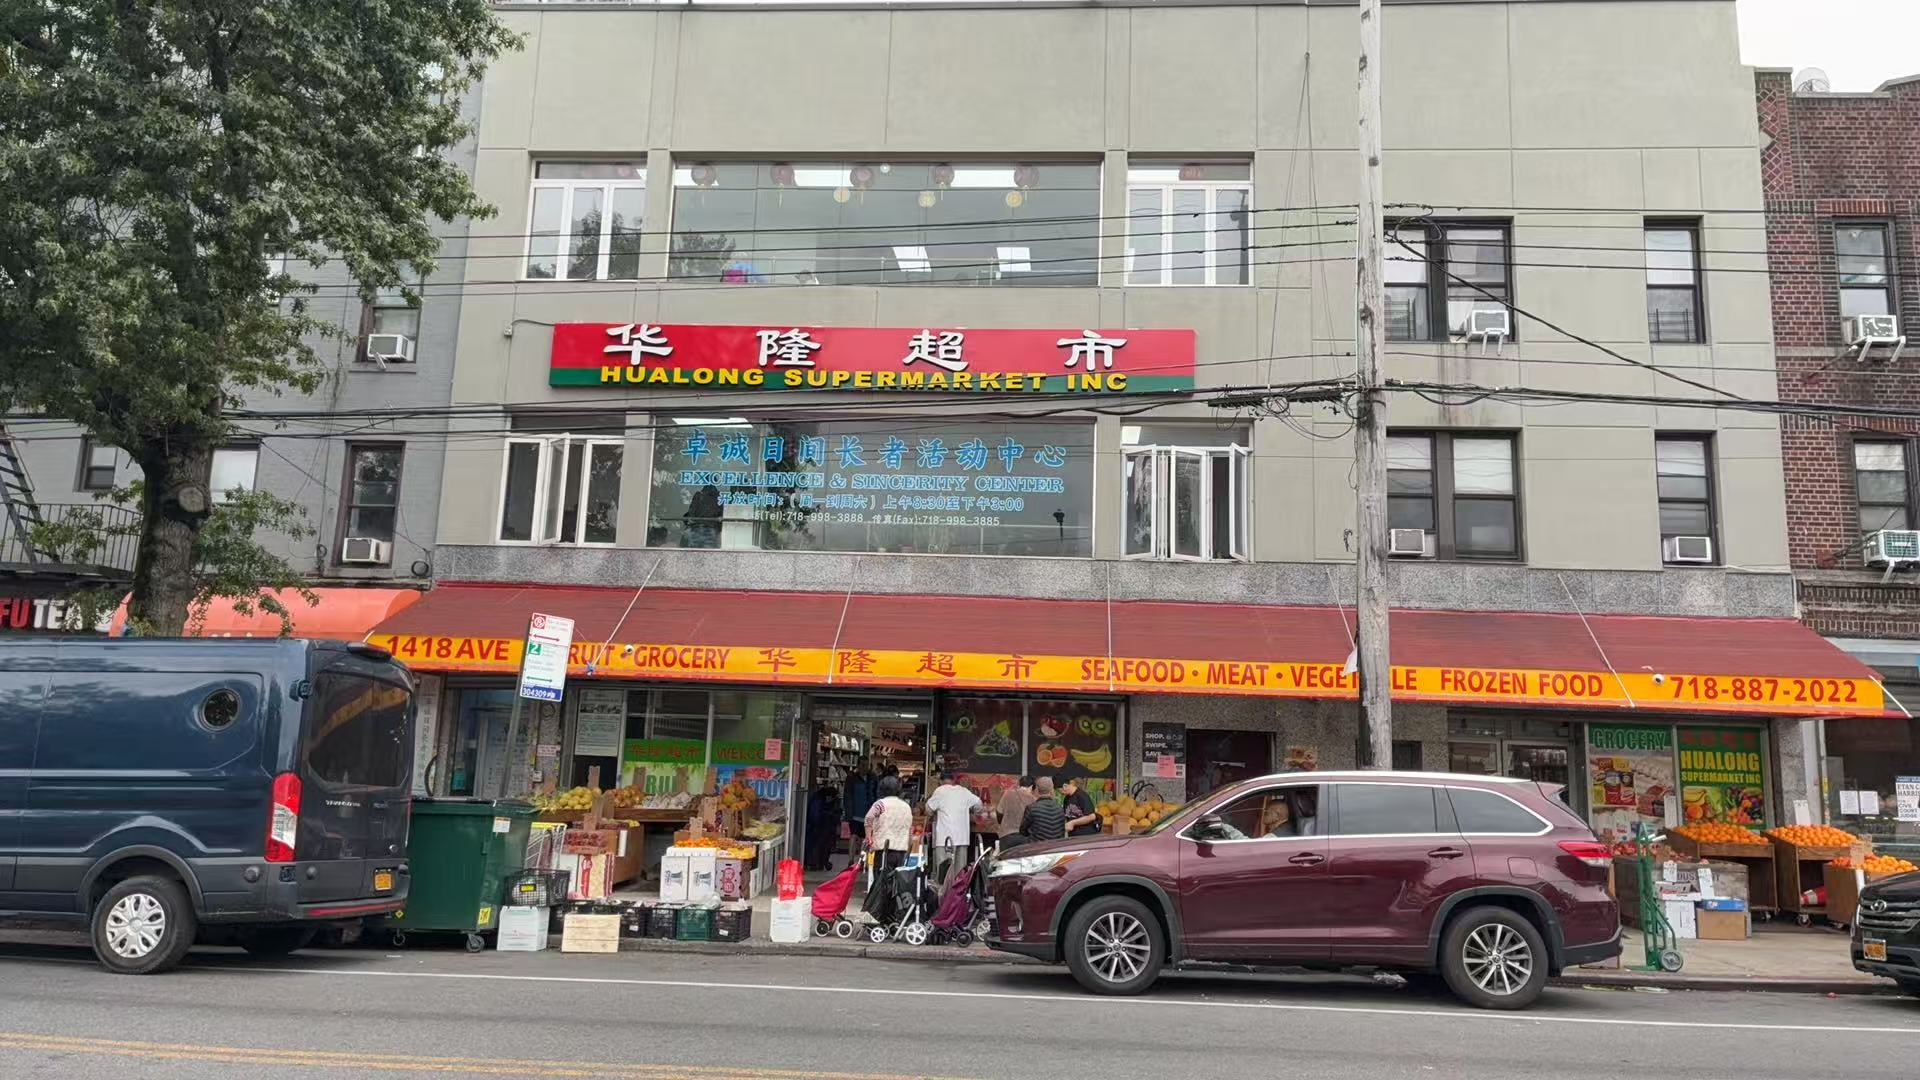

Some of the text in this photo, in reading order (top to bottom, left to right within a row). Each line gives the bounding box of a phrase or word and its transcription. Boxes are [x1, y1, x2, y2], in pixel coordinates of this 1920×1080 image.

[603, 324, 1127, 371] 华隆超市
[601, 366, 1127, 391] HUALONG SUPERMARKET INC
[680, 429, 1066, 473] 卓诚日间长者活动中心
[679, 471, 1064, 493] EXCELLENCE & SINCERITY CENTER
[386, 636, 511, 661] 1418 AVE
[568, 644, 616, 669] RUIT
[633, 646, 731, 669] GROCERY
[757, 648, 1038, 679] 华隆超市
[1080, 658, 1185, 684] SEAFOOD
[1206, 663, 1269, 686] MEAT
[1440, 669, 1603, 697] FROZEN FOOD
[1670, 676, 1858, 704] 718-887-2022
[1593, 728, 1666, 751] GROCERY
[1680, 750, 1760, 772] HUALONG
[1681, 771, 1744, 784] SUPERMARKET
